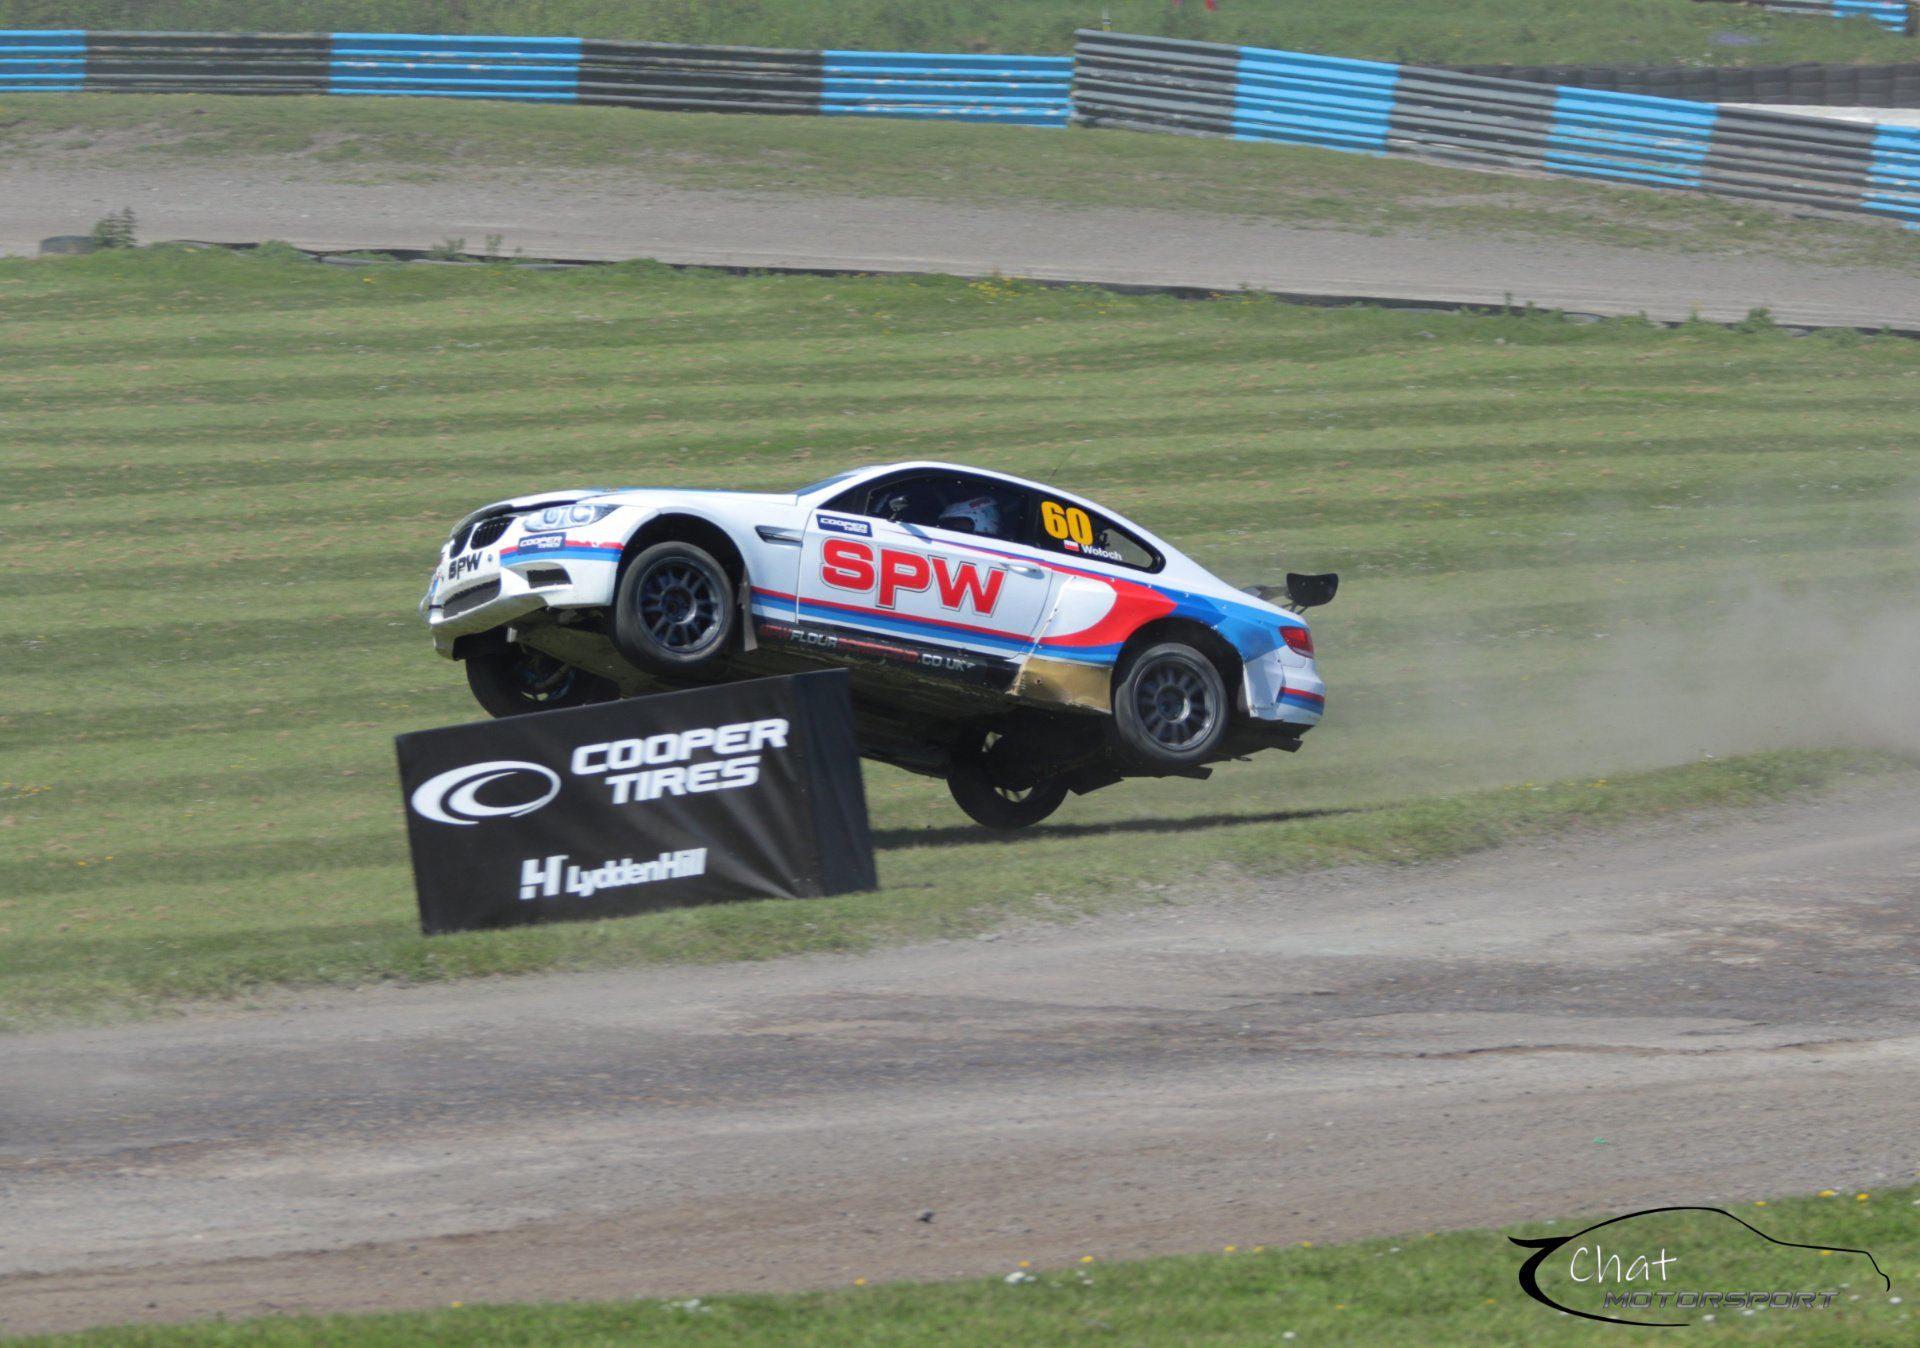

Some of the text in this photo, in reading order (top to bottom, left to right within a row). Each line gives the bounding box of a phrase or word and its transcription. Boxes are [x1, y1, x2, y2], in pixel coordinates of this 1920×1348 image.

[520, 535, 562, 547] COOPER
[820, 518, 868, 530] COOPER
[1041, 501, 1093, 545] 60
[822, 538, 1007, 617] SPW
[571, 718, 789, 775] COOPER
[605, 755, 761, 804] TIRES
